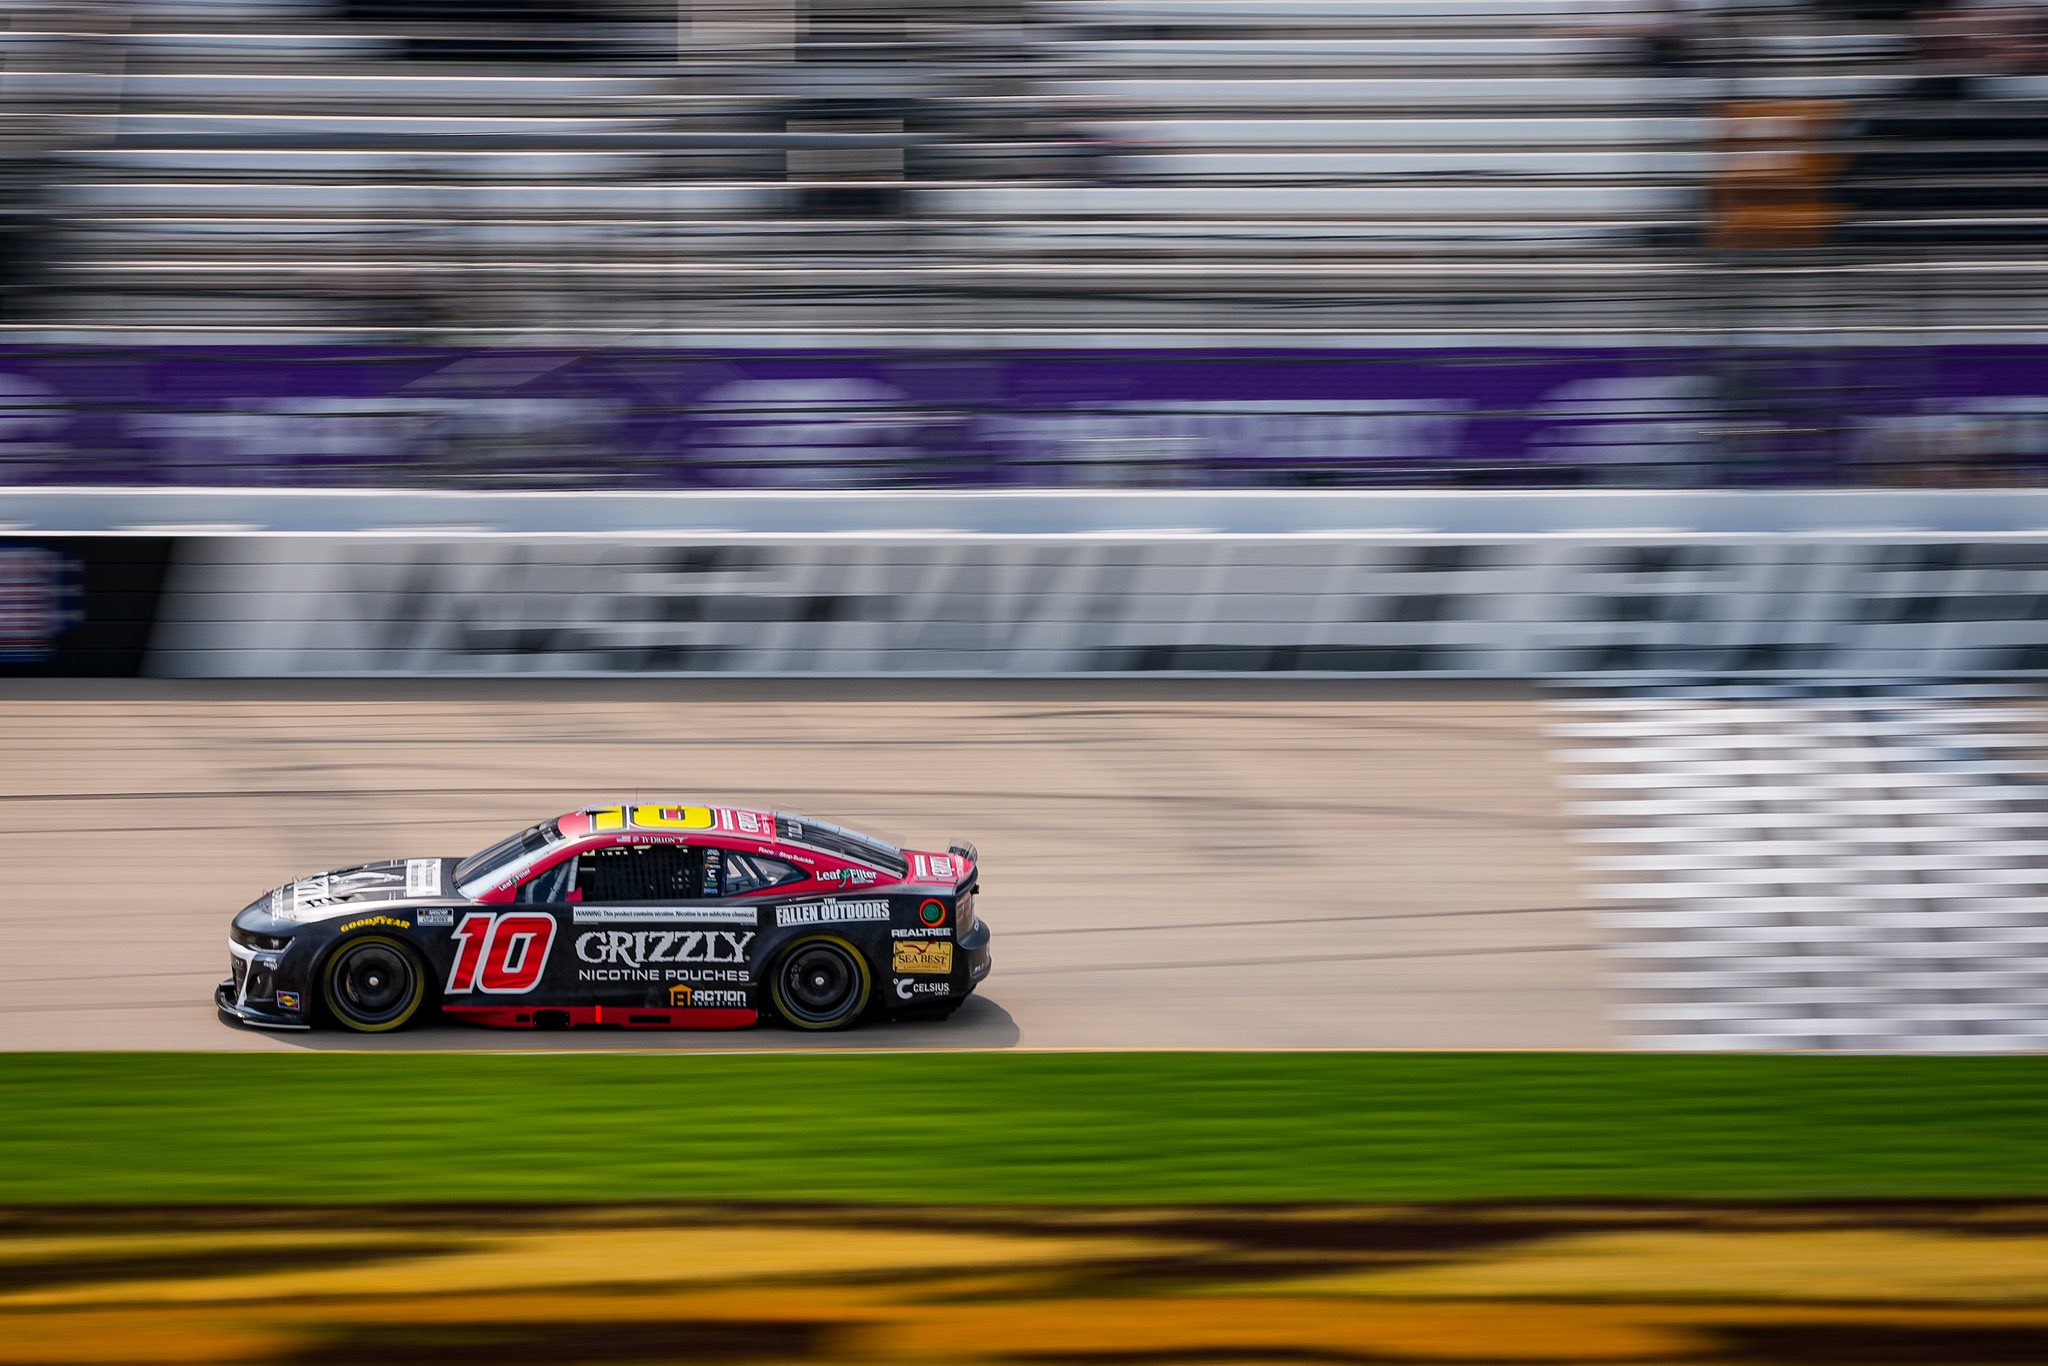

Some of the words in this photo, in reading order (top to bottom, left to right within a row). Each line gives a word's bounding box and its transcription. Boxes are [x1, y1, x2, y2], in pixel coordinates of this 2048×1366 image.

[777, 905, 818, 924] FALLEN
[821, 903, 889, 920] OUTDOORS
[340, 916, 411, 933] GOODYEAR
[891, 928, 951, 938] REALTREE
[444, 912, 557, 994] 10
[575, 930, 755, 969] GRIZZLY
[898, 954, 919, 965] SEA
[921, 954, 947, 965] BEST
[579, 970, 660, 982] NICOTINE
[665, 970, 750, 983] POUCHES
[913, 982, 950, 993] CELSIUS
[692, 990, 747, 1002] ACTION
